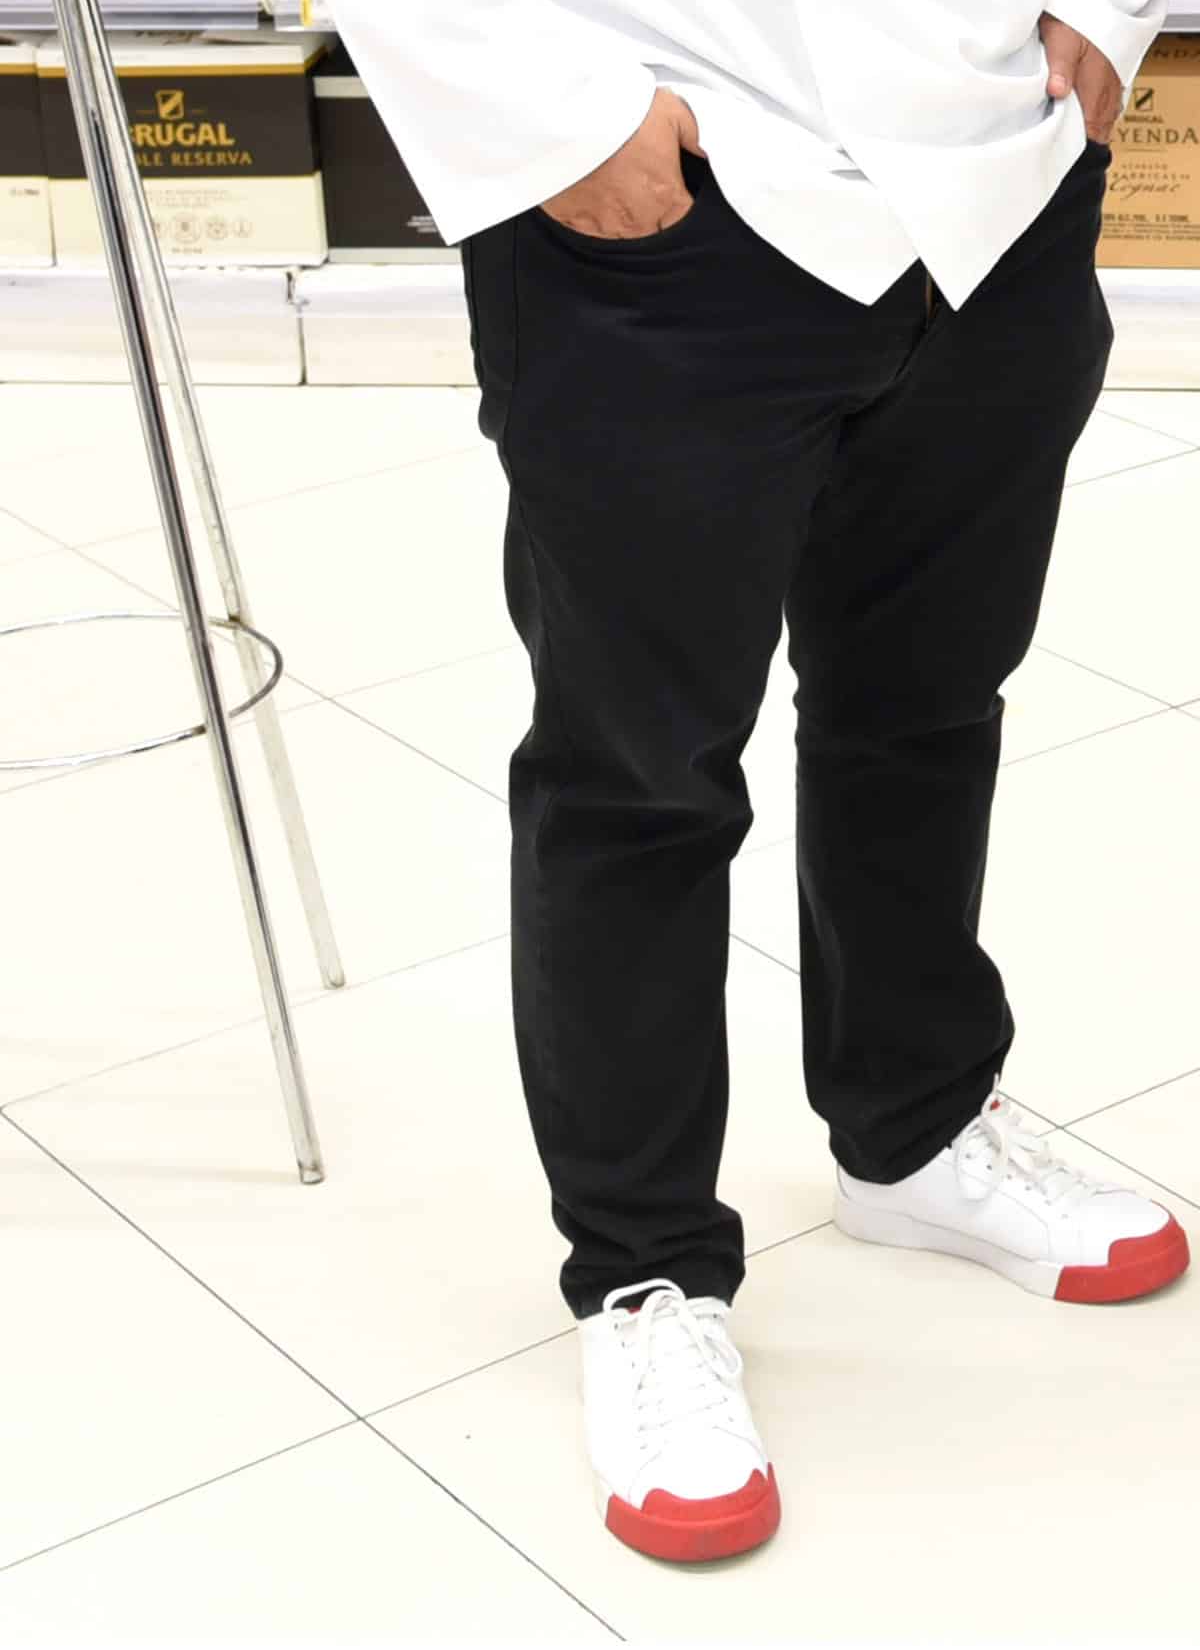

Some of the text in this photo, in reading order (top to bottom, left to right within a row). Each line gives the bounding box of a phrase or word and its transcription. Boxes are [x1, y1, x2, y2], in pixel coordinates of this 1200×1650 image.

[129, 123, 235, 147] RUGAL
[1117, 128, 1199, 144] YENDA
[171, 152, 252, 166] RESERVA
